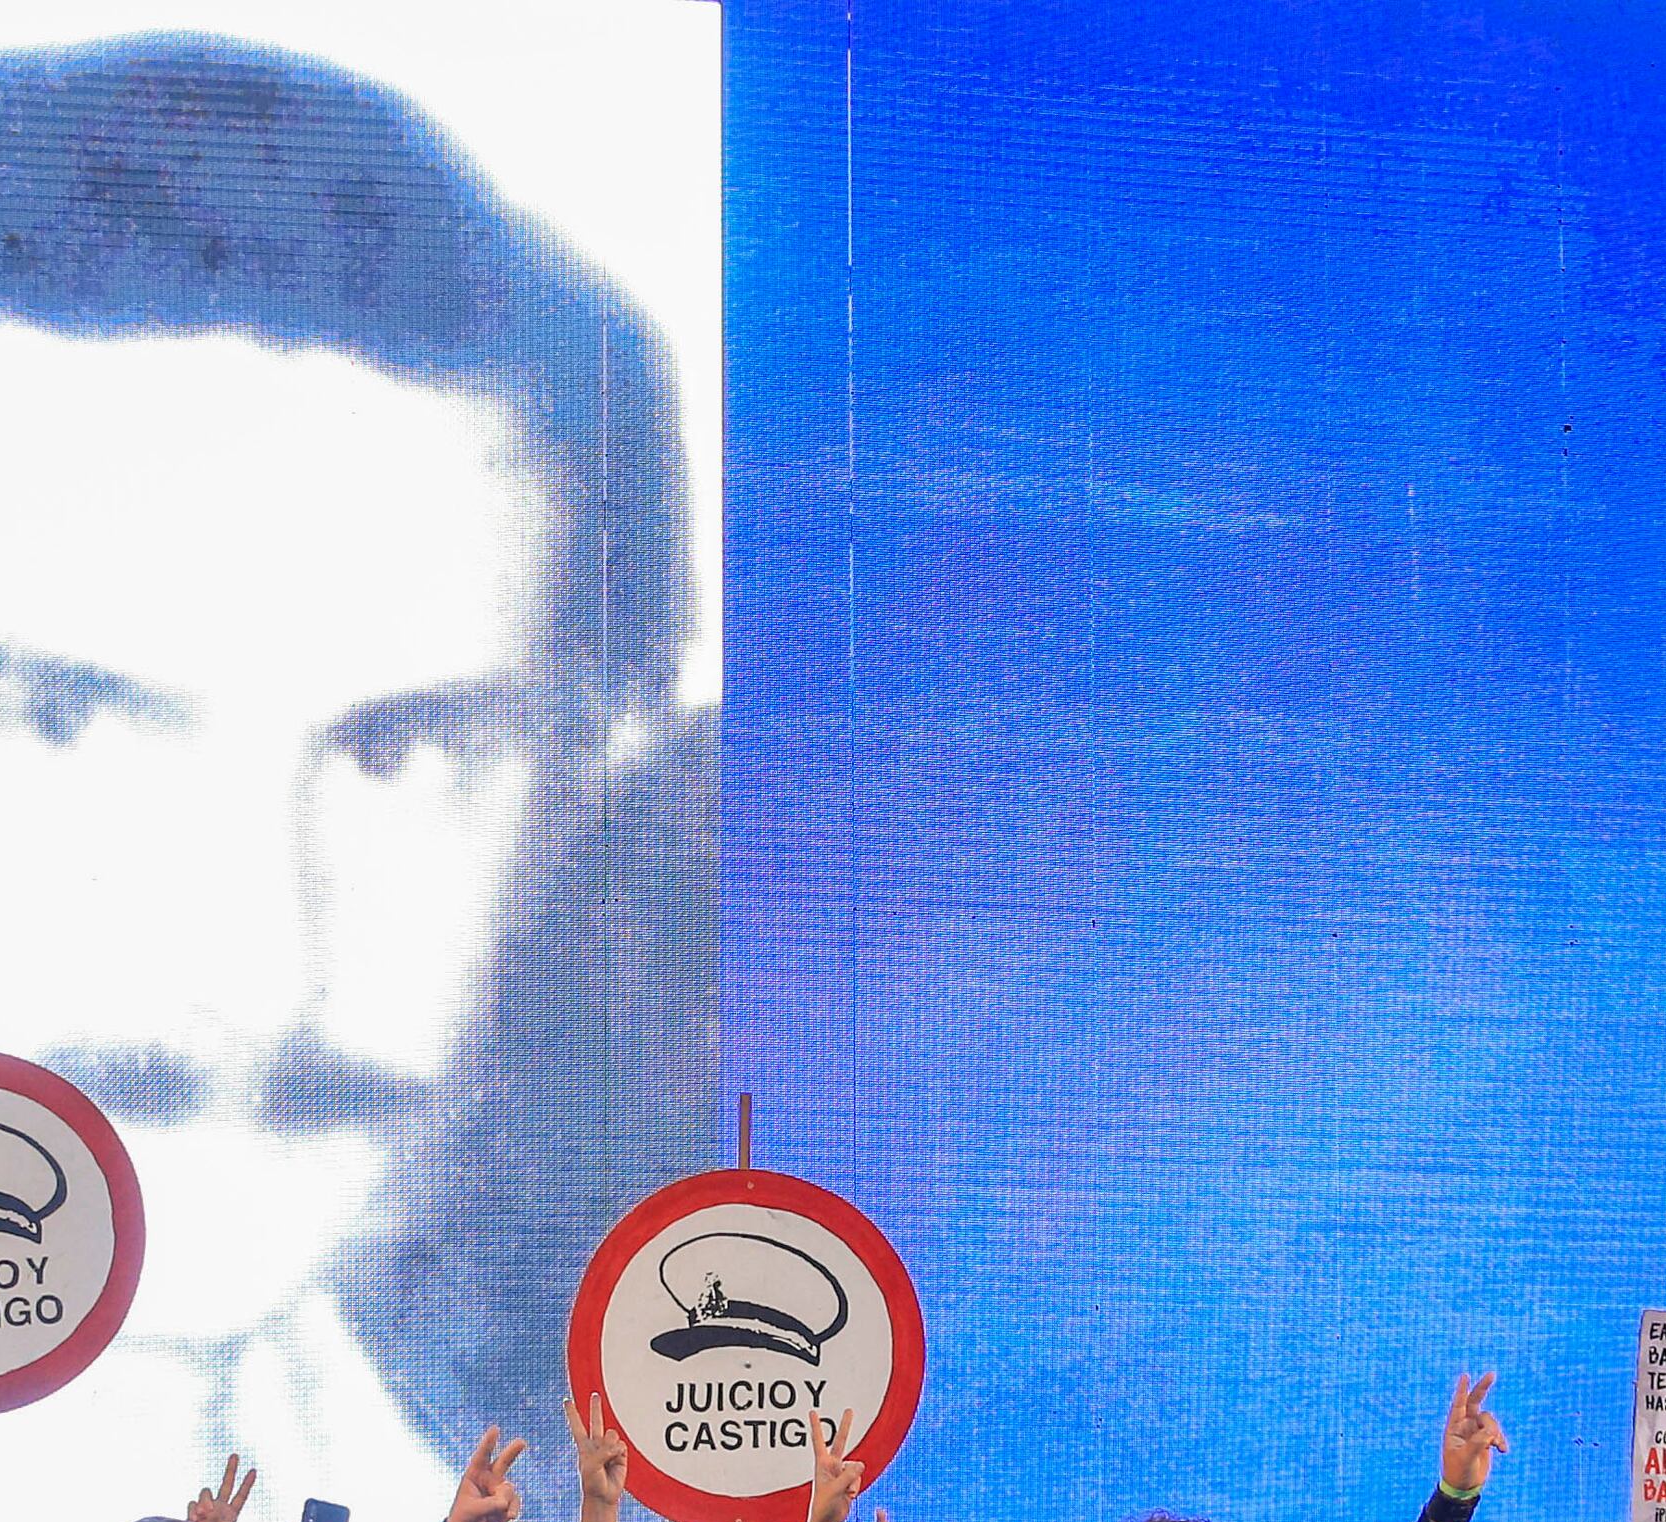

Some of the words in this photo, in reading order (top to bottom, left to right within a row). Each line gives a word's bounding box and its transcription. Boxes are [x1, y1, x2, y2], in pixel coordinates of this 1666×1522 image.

[25, 1256, 50, 1285] Y
[666, 1380, 797, 1413] JUICIO
[804, 1380, 828, 1408] Y
